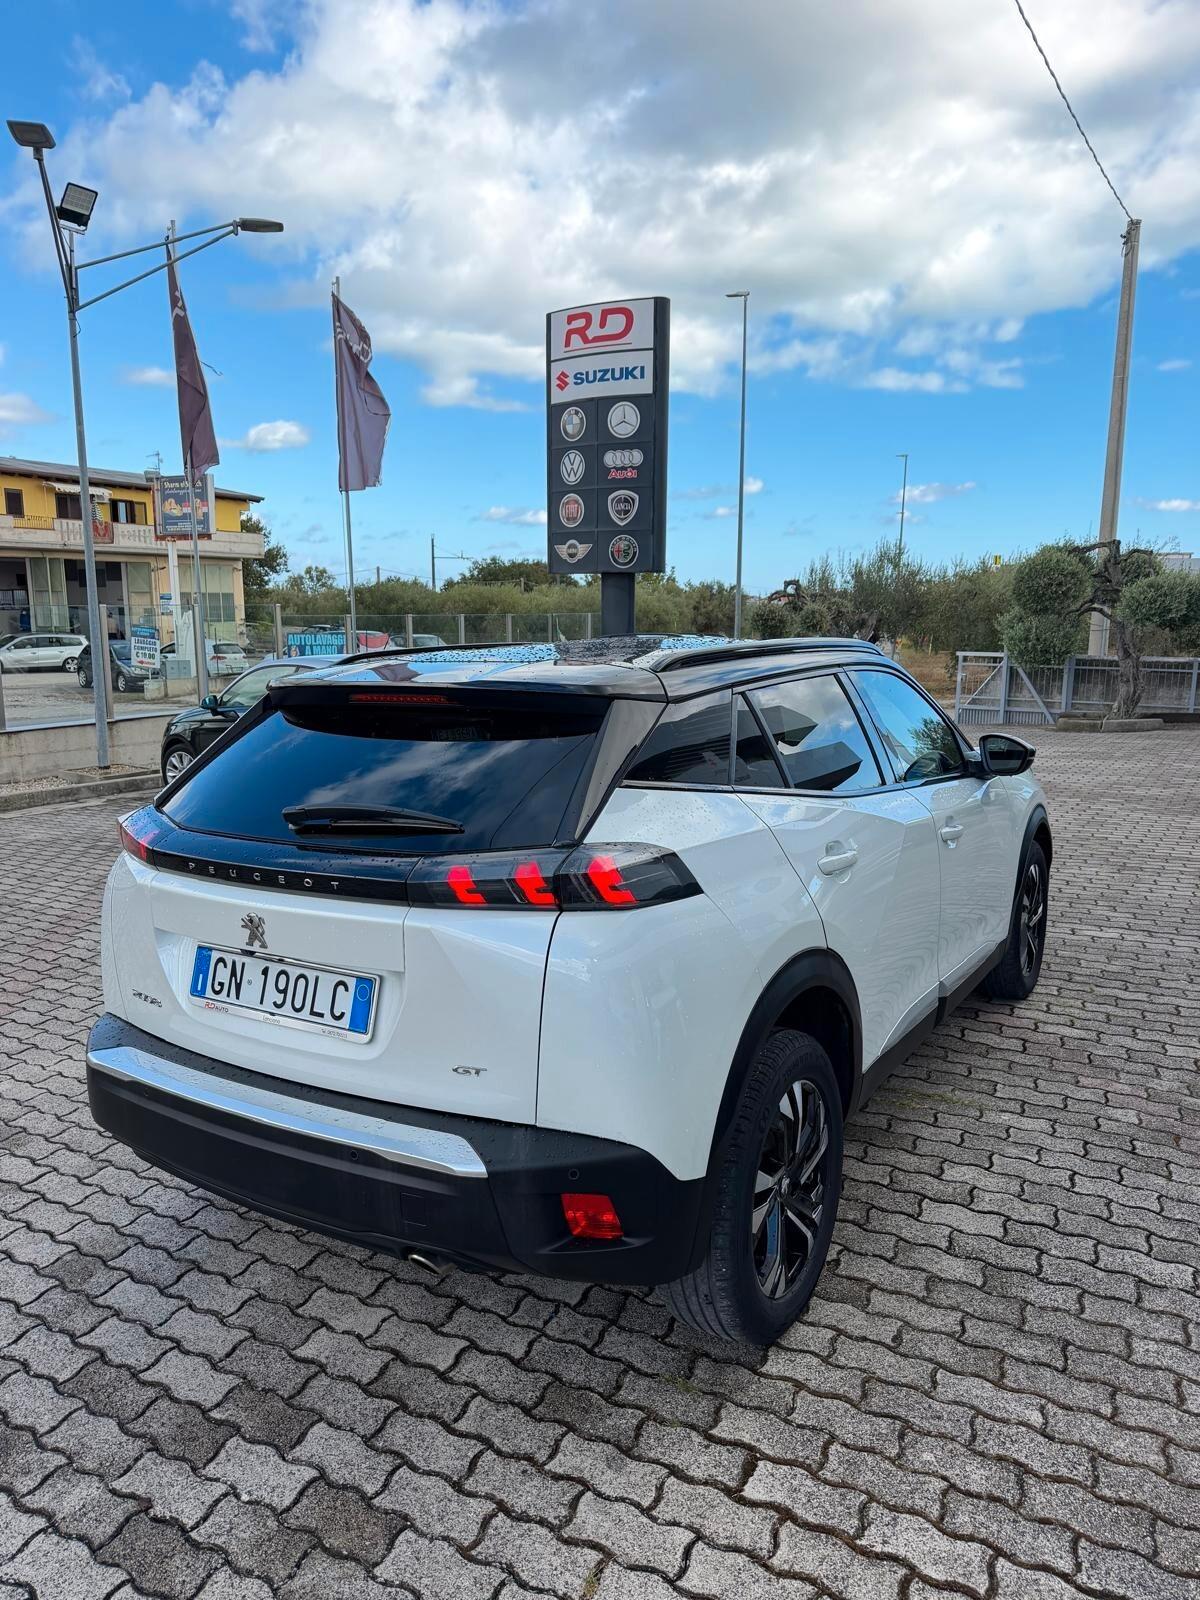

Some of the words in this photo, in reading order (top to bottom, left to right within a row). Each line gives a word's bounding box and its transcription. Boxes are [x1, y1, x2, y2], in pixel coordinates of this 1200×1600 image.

[564, 307, 634, 348] RD
[573, 365, 645, 386] SUZUKI
[607, 467, 638, 479] Audi
[565, 504, 579, 518] FIAT
[614, 502, 631, 511] LANCIA
[313, 645, 338, 656] MANO
[187, 861, 340, 891] PEUGEOT
[210, 956, 246, 1001] GN
[259, 965, 350, 1022] 190LC
[215, 1004, 229, 1013] AUTO
[452, 1065, 488, 1077] GT
